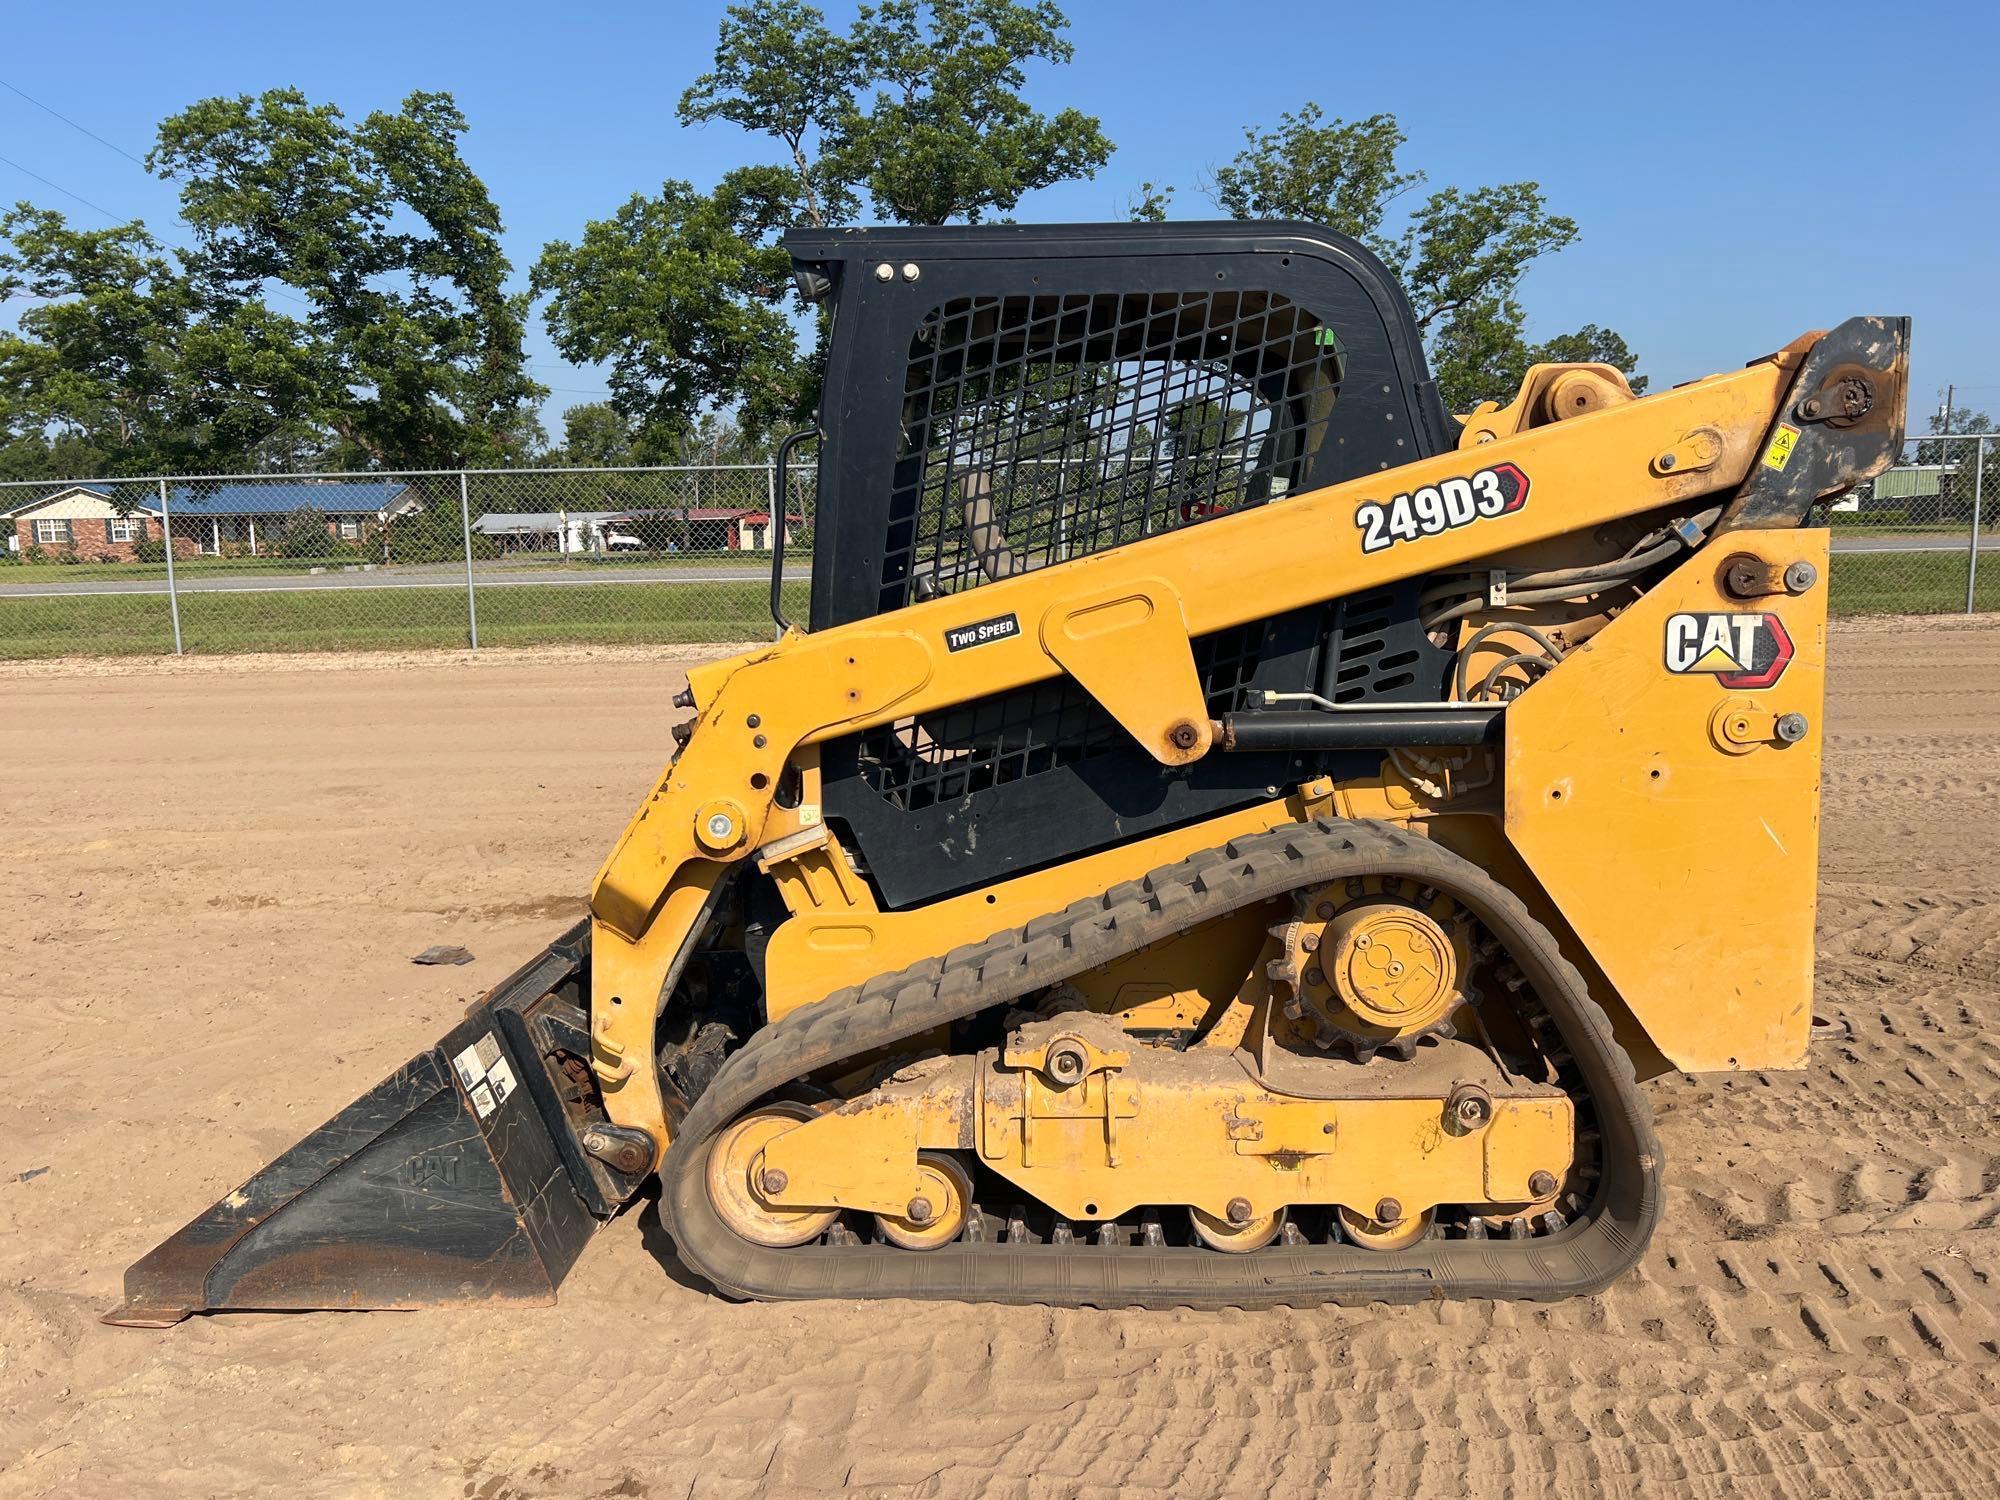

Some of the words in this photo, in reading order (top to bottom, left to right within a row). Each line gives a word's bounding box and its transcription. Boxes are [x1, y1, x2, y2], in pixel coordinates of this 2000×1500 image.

[1357, 470, 1505, 551] 249D3
[1666, 614, 1763, 671] CAT
[406, 1155, 458, 1187] CAT
